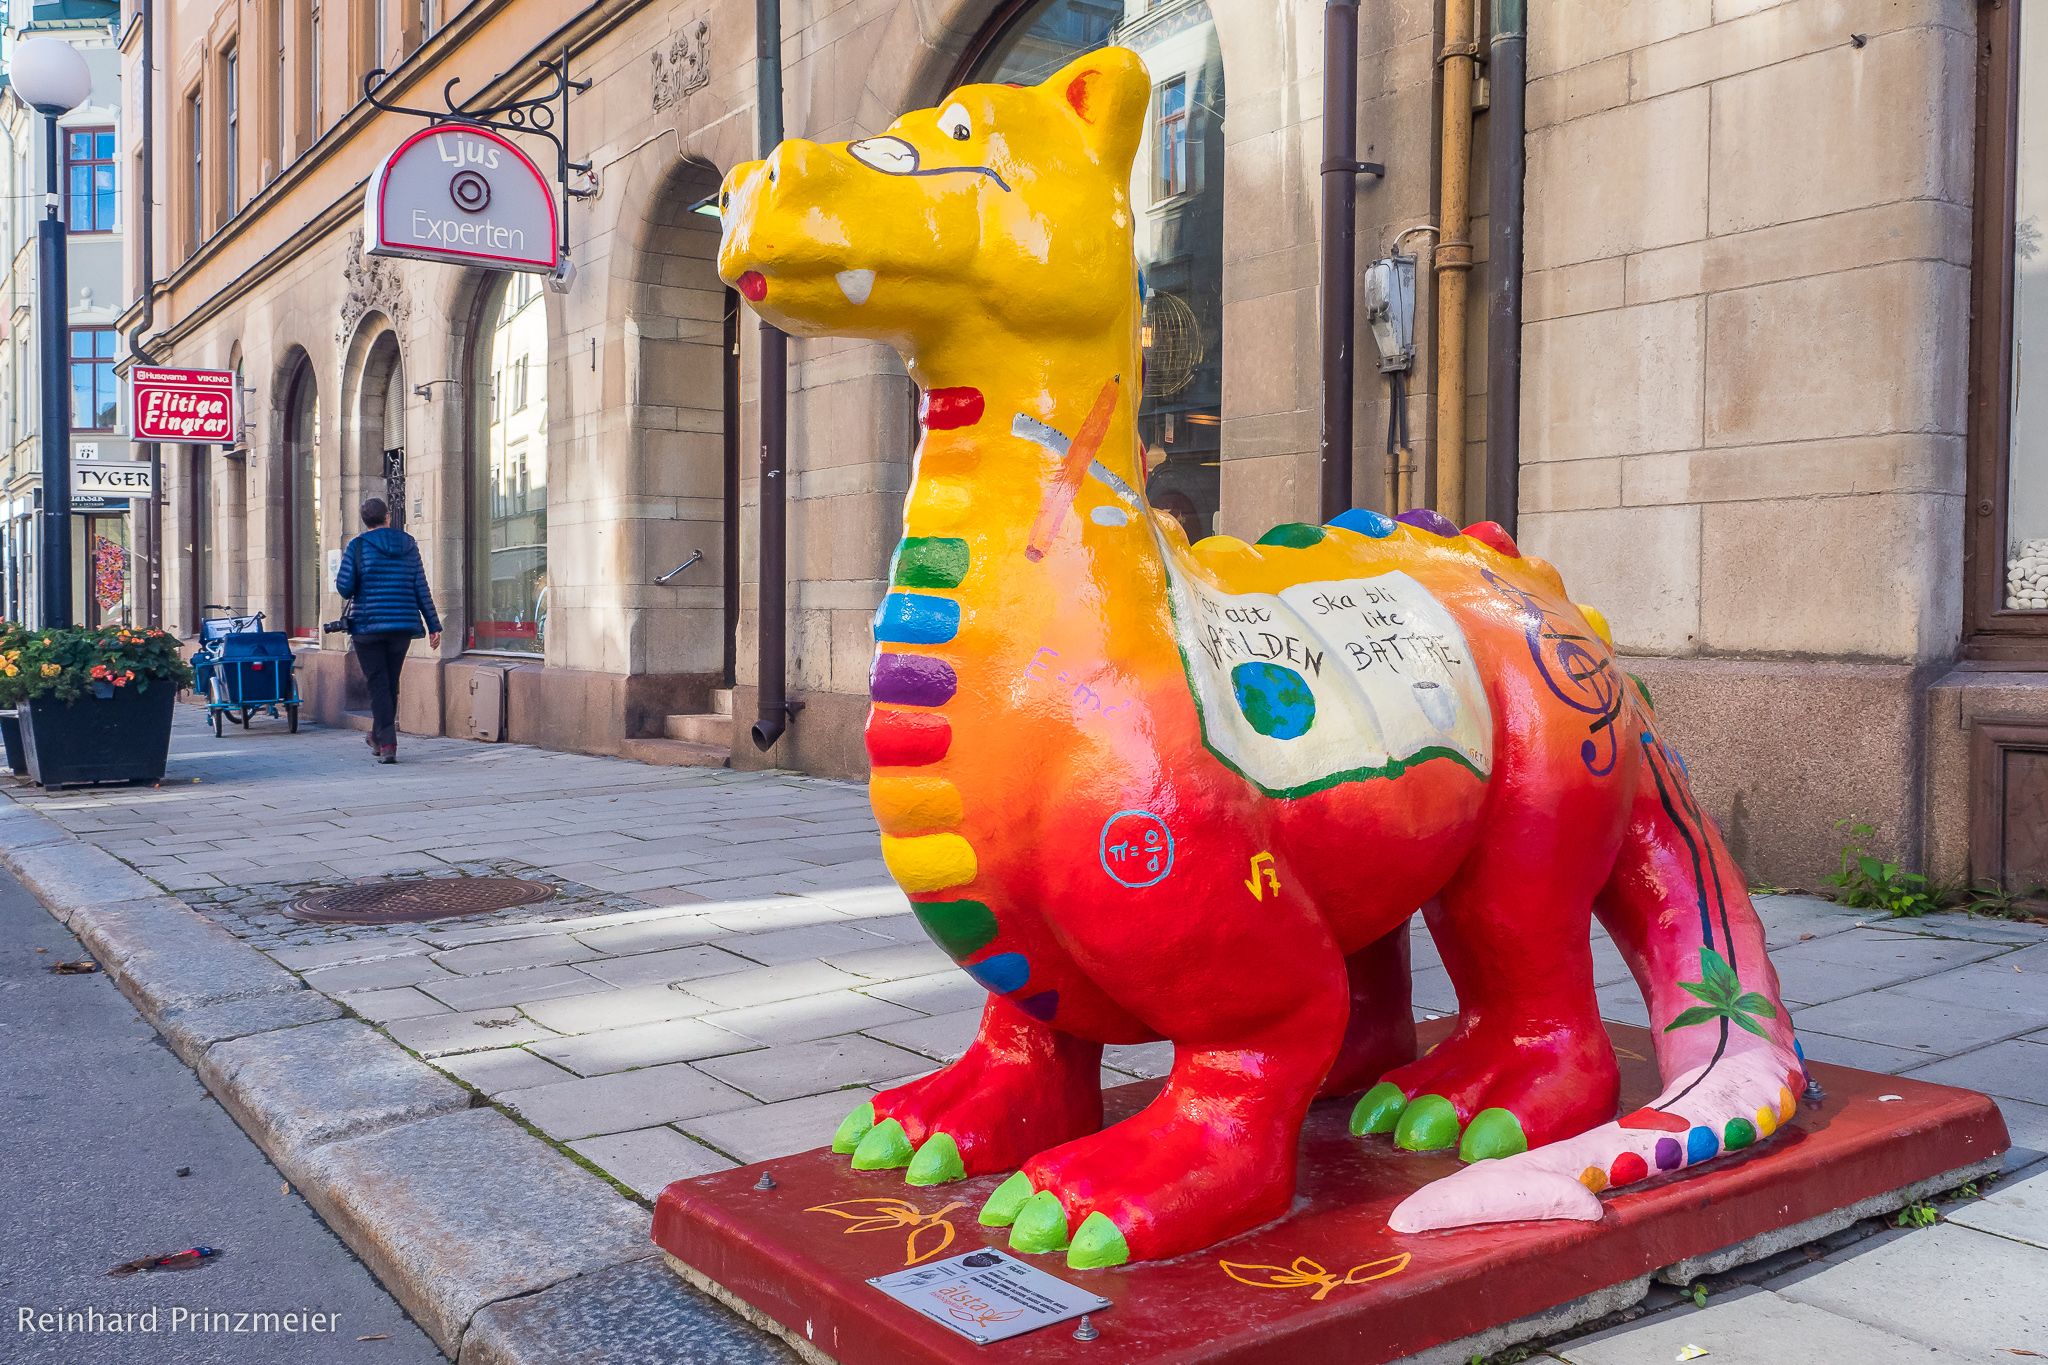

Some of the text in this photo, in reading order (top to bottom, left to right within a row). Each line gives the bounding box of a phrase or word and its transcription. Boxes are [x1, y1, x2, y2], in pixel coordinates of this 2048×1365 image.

[436, 132, 501, 170] Ljus
[412, 209, 524, 250] Experten
[197, 375, 229, 383] VIKING
[148, 392, 223, 417] Flitiga
[145, 410, 227, 435] Fingrar
[77, 471, 150, 487] TYGER
[1312, 586, 1397, 615] ska bli
[1225, 606, 1271, 625] att
[1361, 609, 1404, 629] lite
